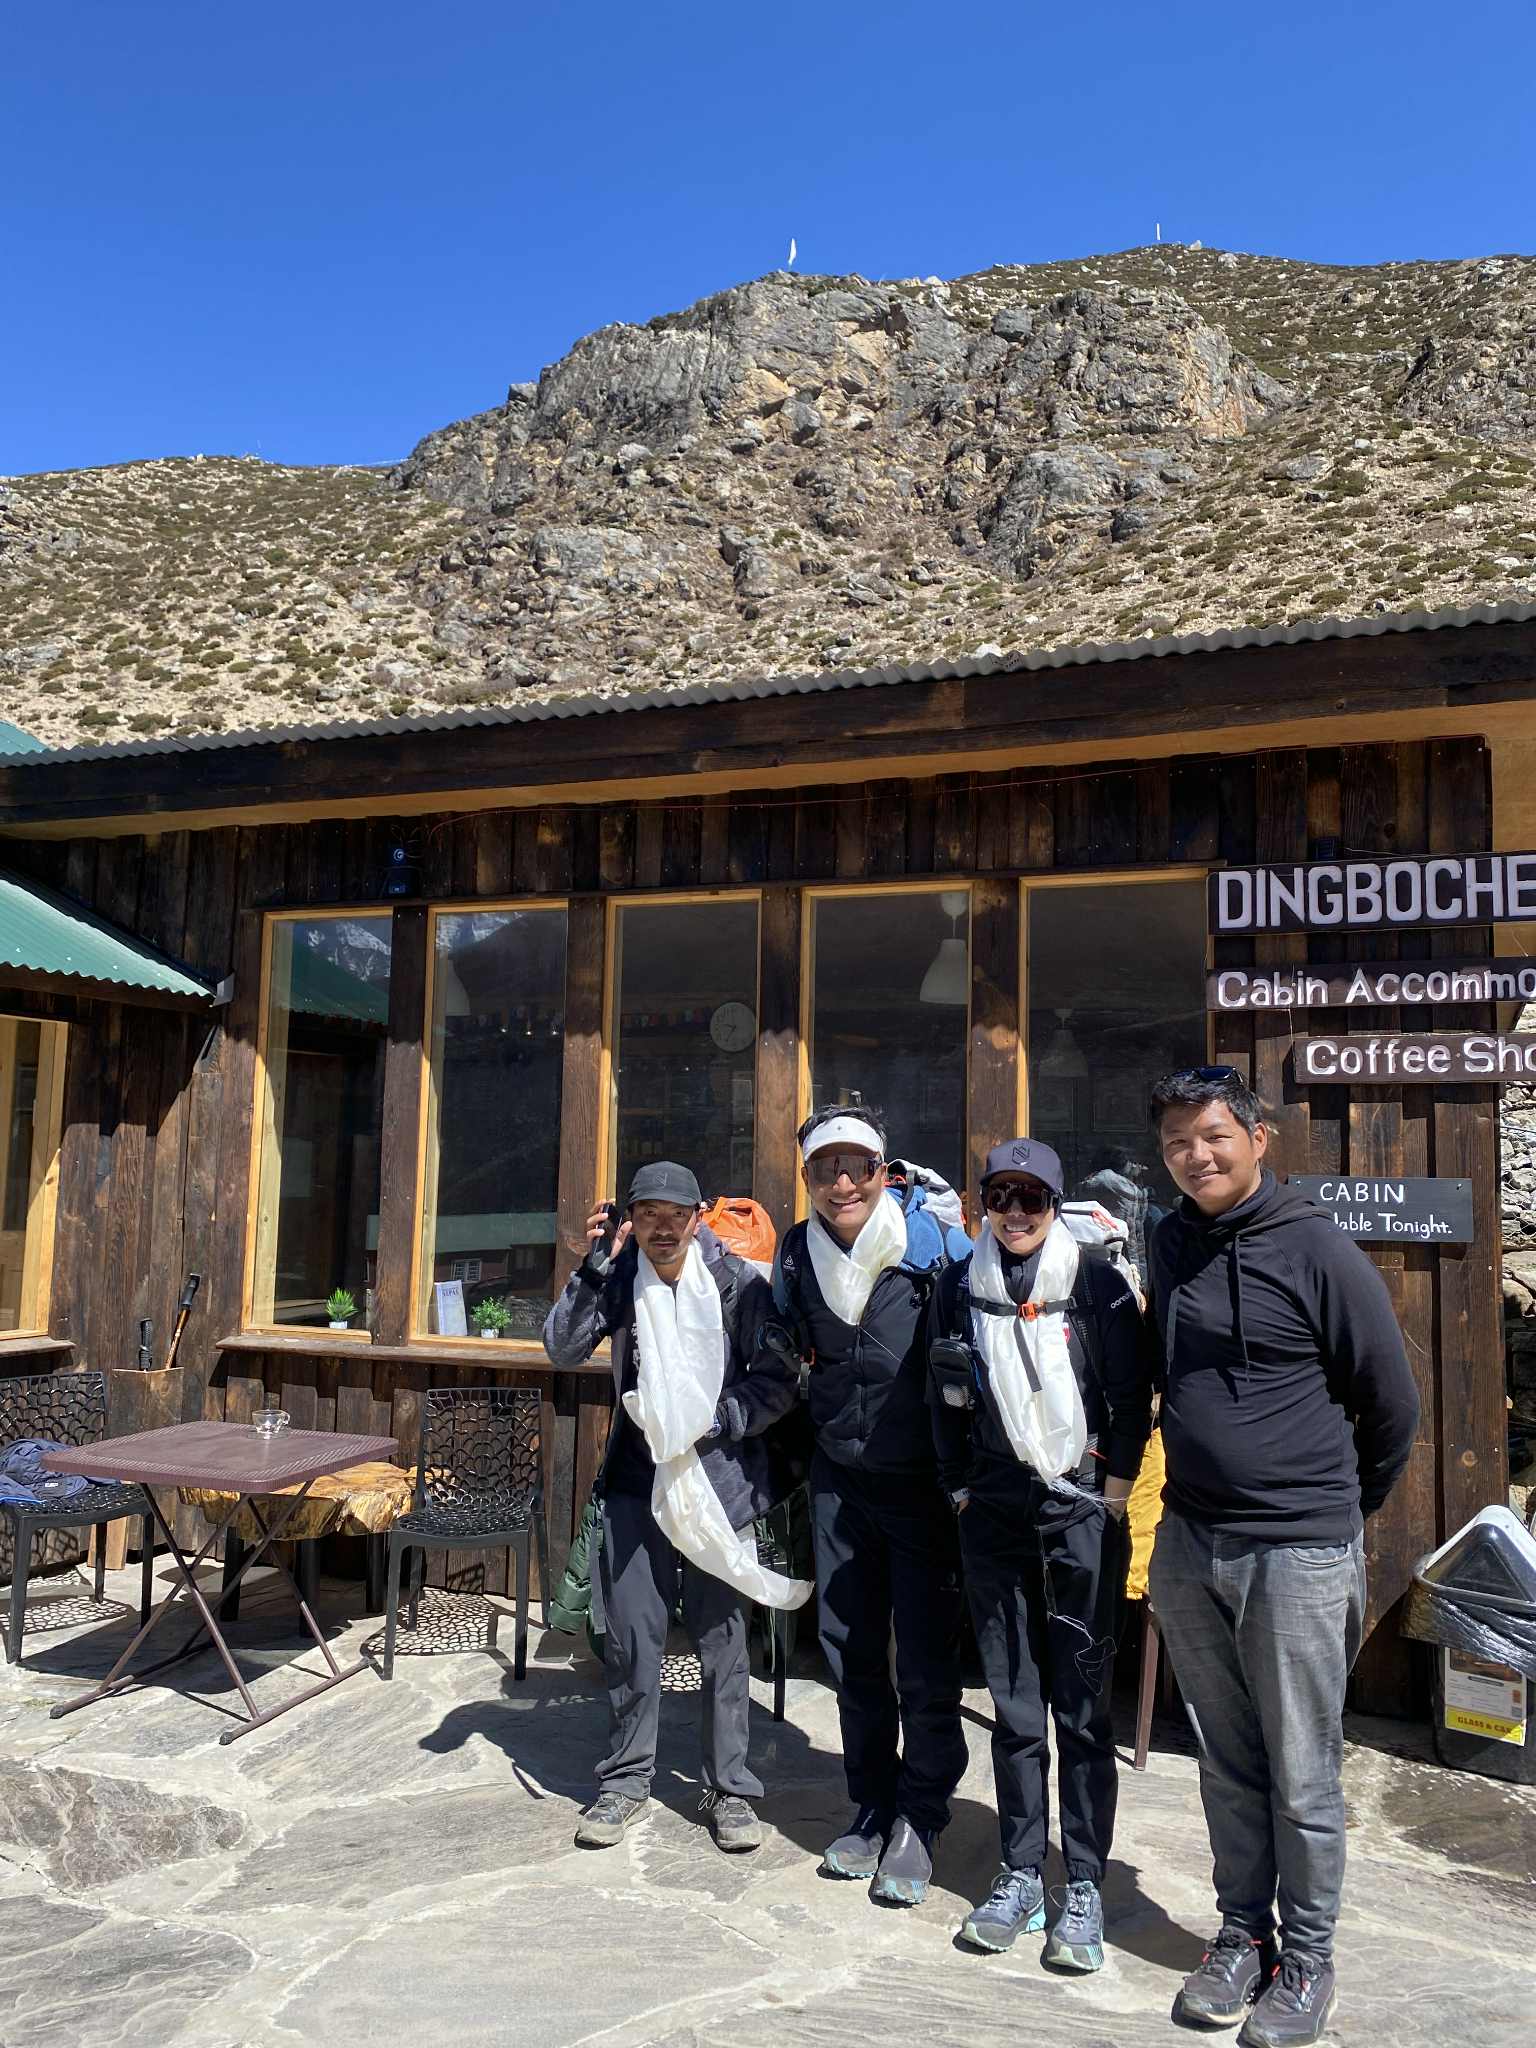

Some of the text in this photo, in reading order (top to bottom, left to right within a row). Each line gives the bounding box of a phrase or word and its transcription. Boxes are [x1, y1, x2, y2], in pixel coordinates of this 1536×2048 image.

[1218, 855, 1536, 929] DINGBOCHE
[1217, 967, 1536, 1007] Cabin Accommo
[1306, 1038, 1451, 1075] Coffee
[1320, 1182, 1405, 1203] CABIN
[1378, 1213, 1452, 1239] Tonight.
